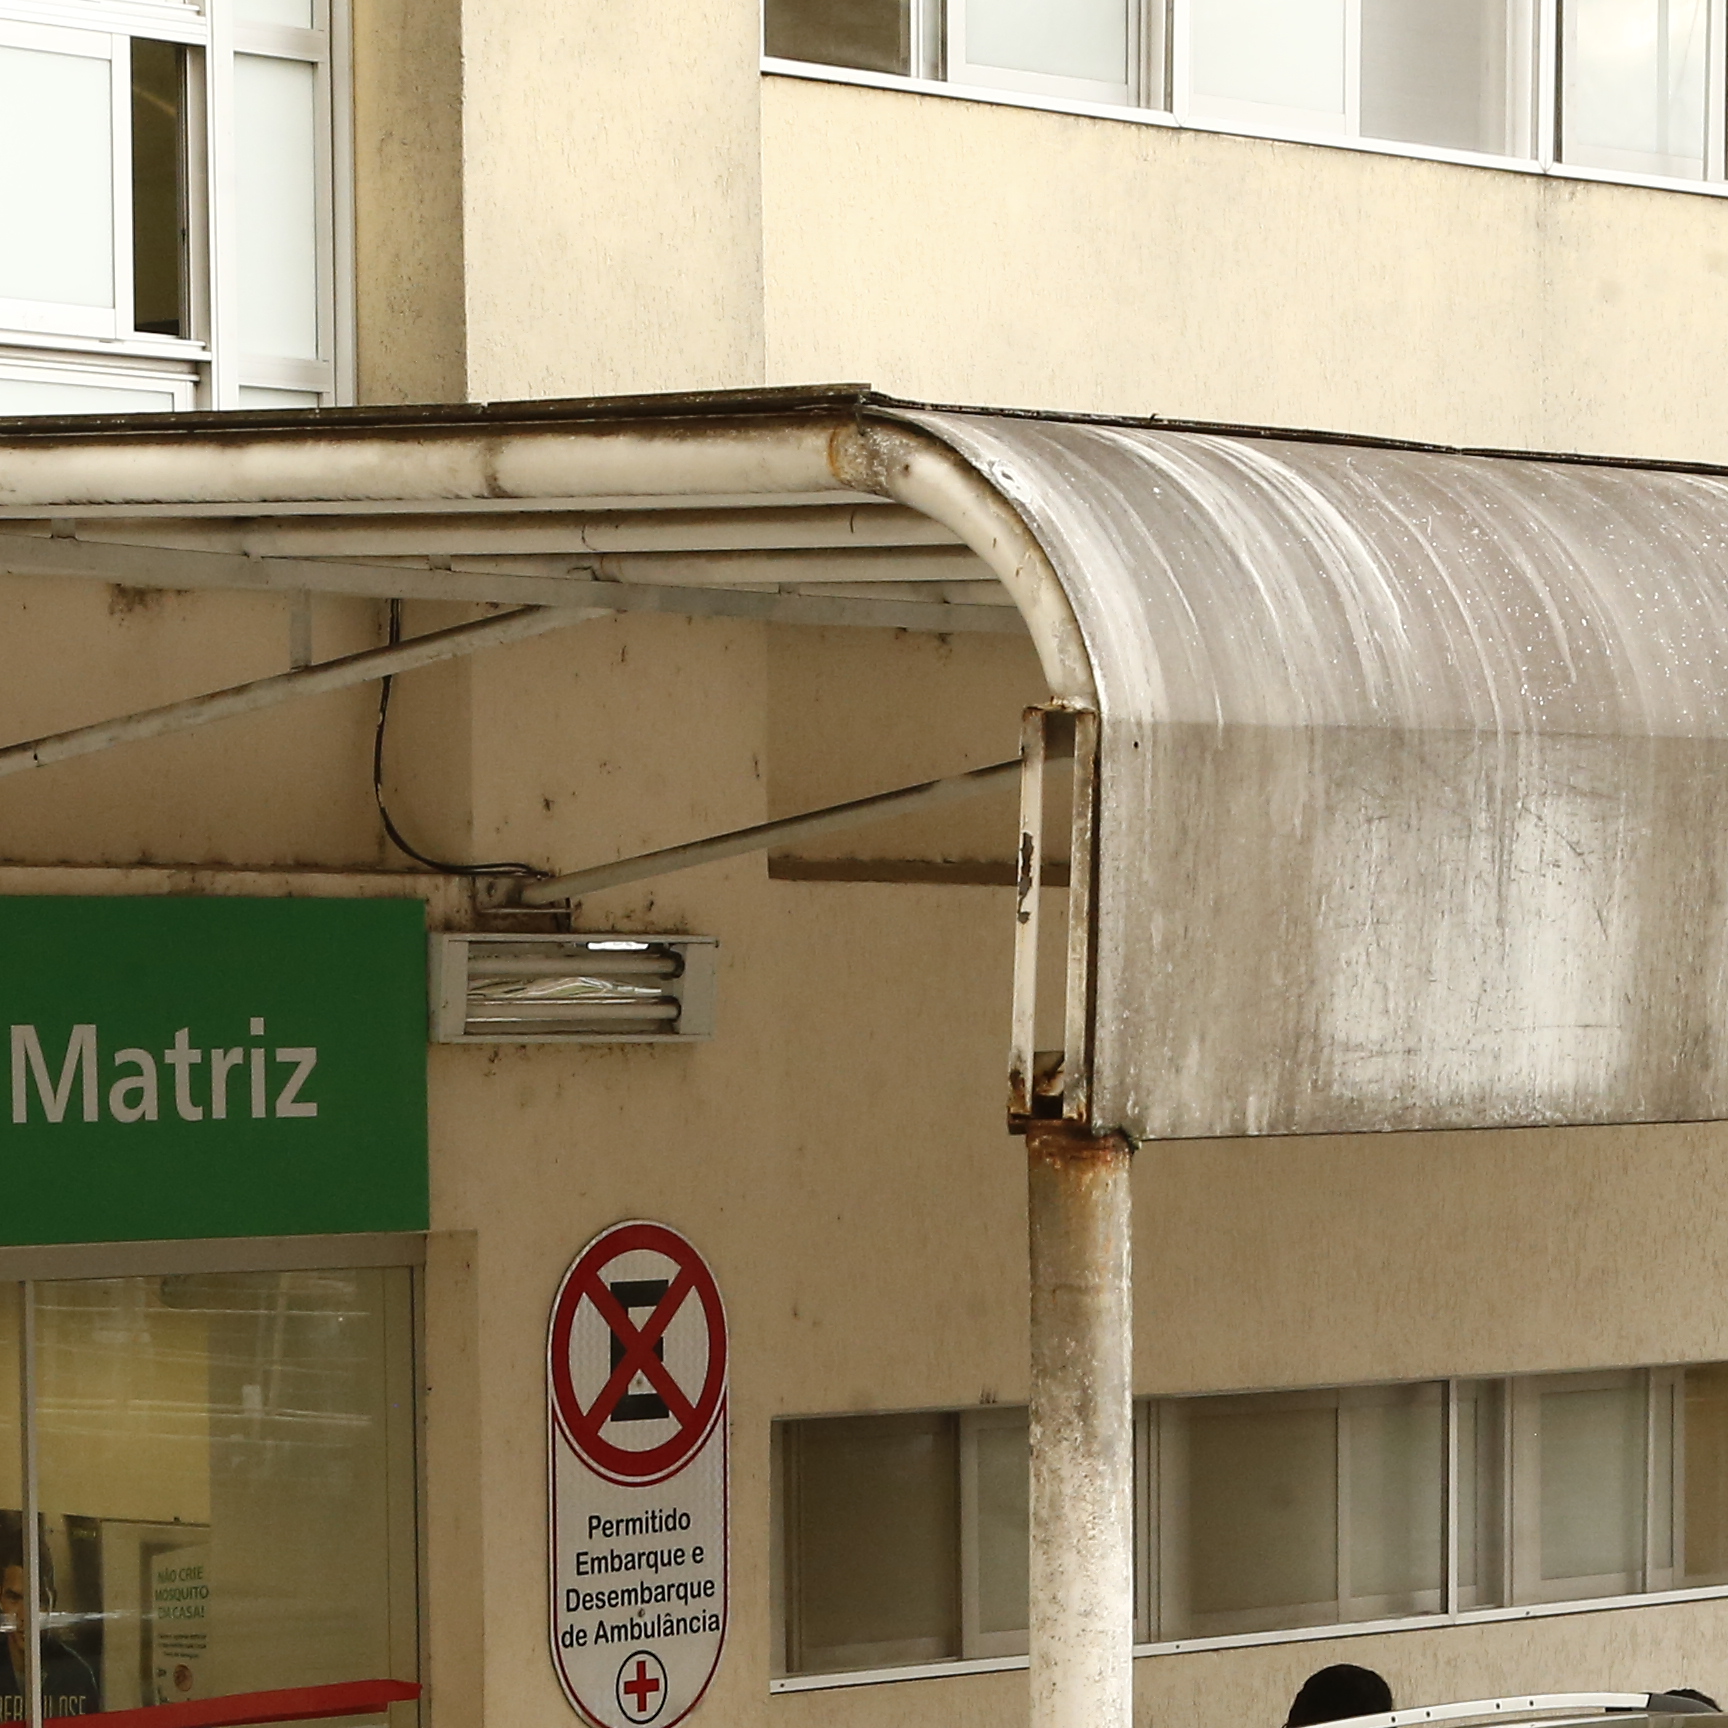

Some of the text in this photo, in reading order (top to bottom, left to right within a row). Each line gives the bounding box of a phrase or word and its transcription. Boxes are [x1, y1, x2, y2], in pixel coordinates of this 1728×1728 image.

[10, 1017, 319, 1124] Matriz
[587, 1508, 692, 1540] Permitido
[575, 1546, 705, 1577] Embarque e
[565, 1579, 716, 1613] Desembarque
[561, 1609, 721, 1649] de Ambulância
